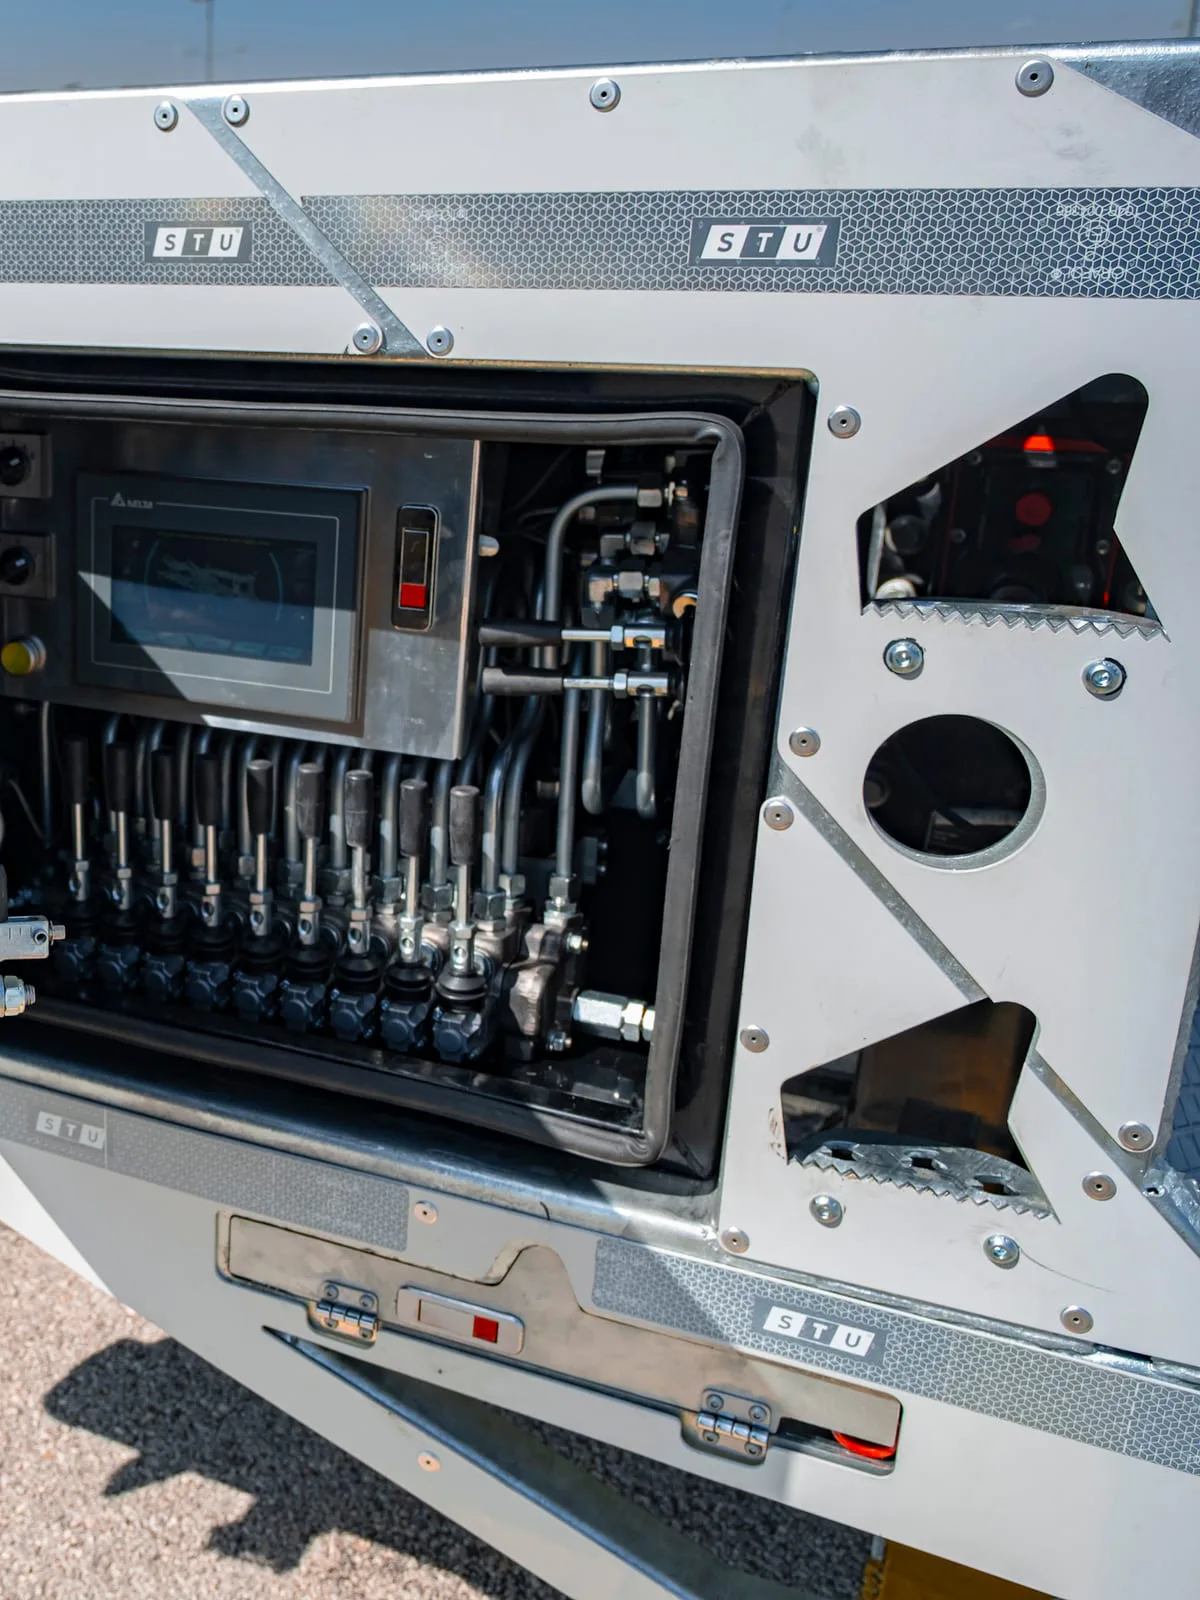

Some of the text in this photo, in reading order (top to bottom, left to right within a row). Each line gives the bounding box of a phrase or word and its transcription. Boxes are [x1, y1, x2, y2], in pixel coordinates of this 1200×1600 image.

[161, 231, 235, 253] STU
[714, 230, 815, 255] STU
[42, 1116, 100, 1144] STU
[775, 1312, 864, 1350] STU
